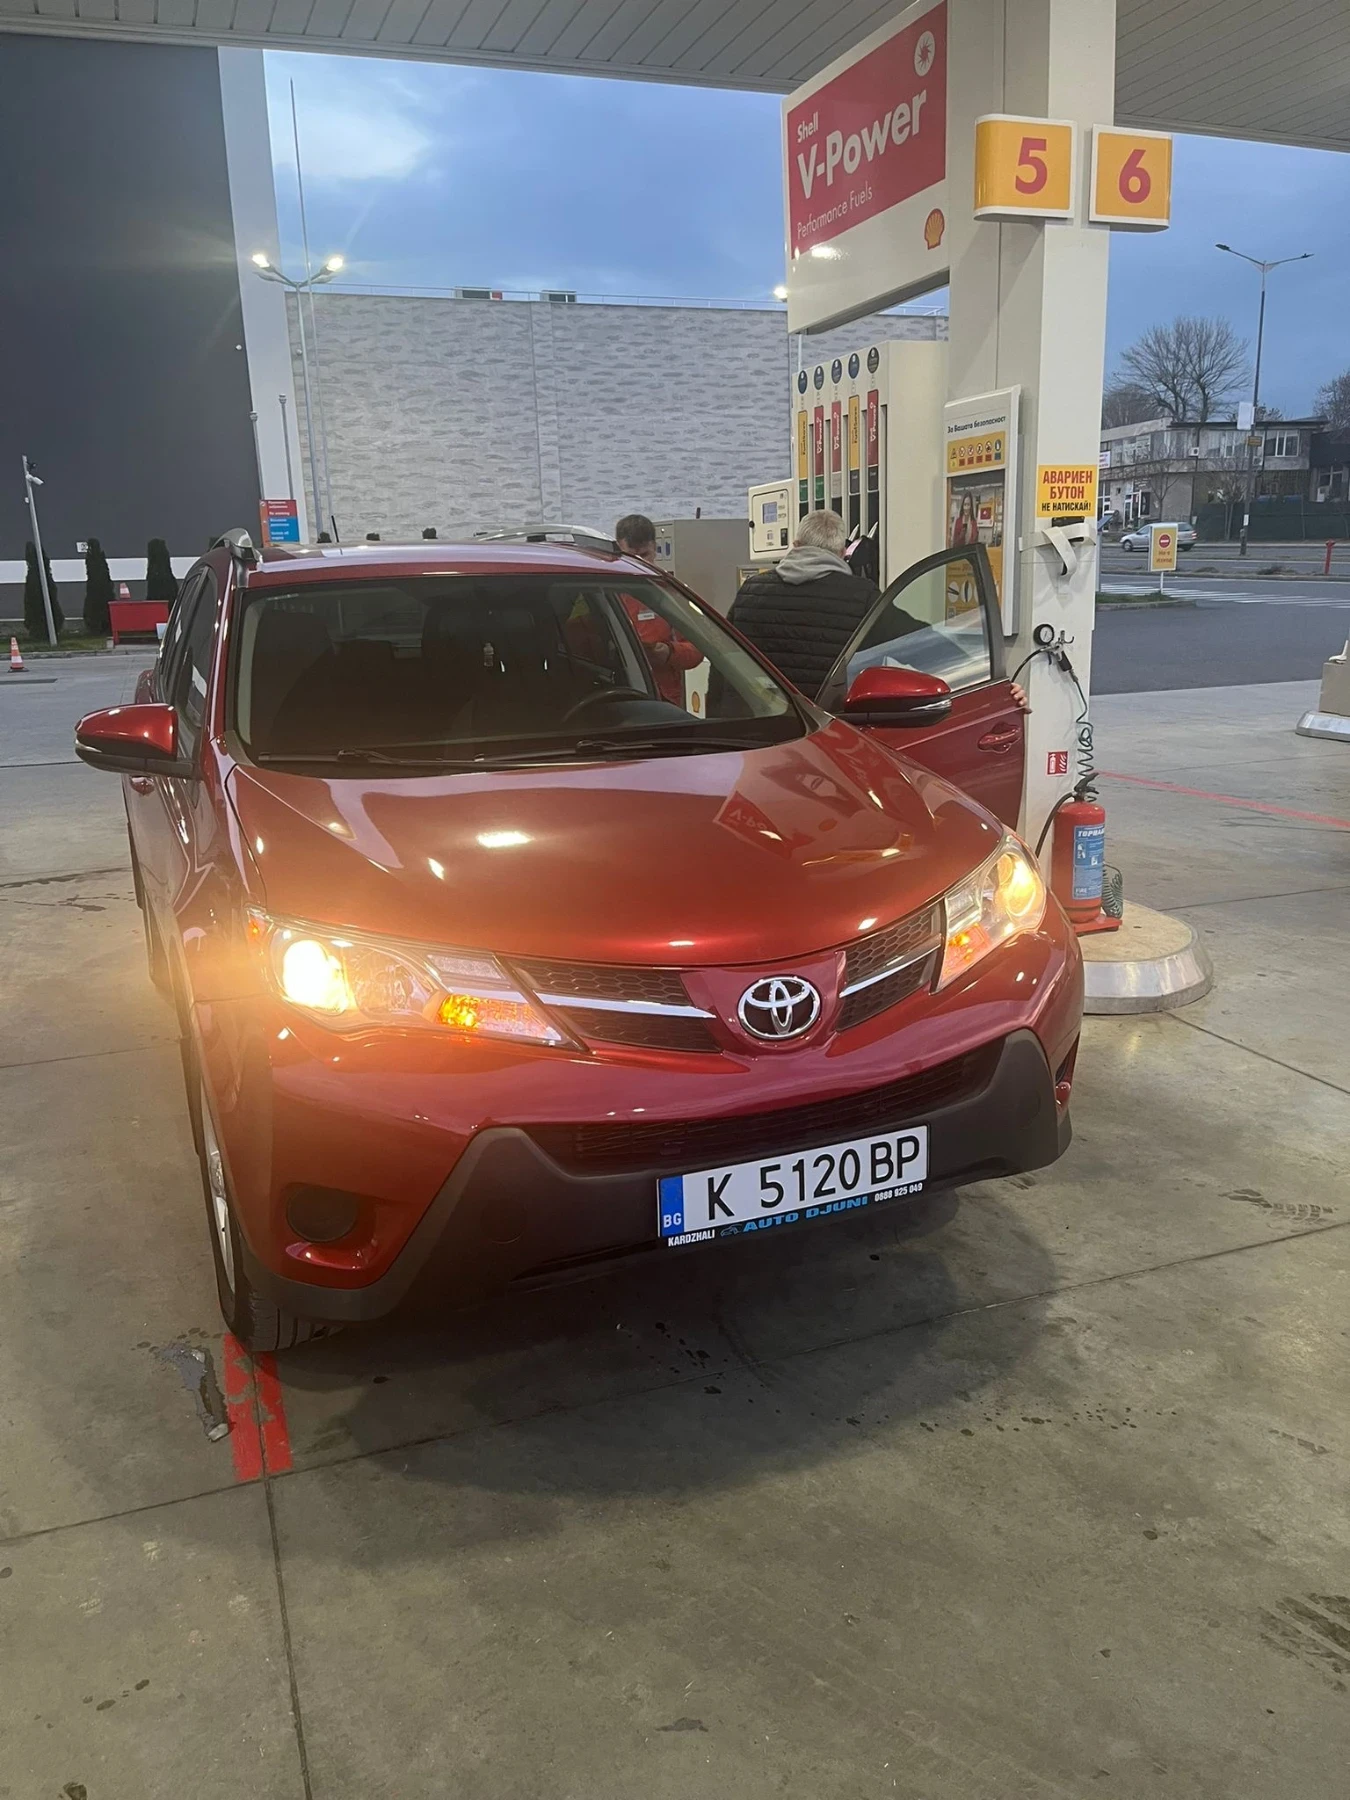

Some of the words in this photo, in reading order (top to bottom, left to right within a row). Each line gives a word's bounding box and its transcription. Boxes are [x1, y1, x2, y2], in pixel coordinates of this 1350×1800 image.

[797, 111, 819, 143] Shell
[797, 90, 927, 199] V-Power
[1015, 137, 1048, 194] 5
[1118, 149, 1152, 204] 6
[797, 201, 848, 240] Performance
[849, 181, 873, 210] Fuels
[1043, 471, 1093, 484] АВАРИЕН
[1050, 486, 1084, 499] БУТОН
[1042, 503, 1051, 511] НЕ
[1053, 500, 1091, 511] НАТИСКАЙ!
[707, 1173, 735, 1220] K
[760, 1148, 861, 1209] 5120
[871, 1135, 920, 1186] BP
[663, 1213, 682, 1228] BG
[668, 1229, 716, 1247] KARDZHALI
[743, 1212, 799, 1232] AUTO
[805, 1196, 868, 1219] DJUNI
